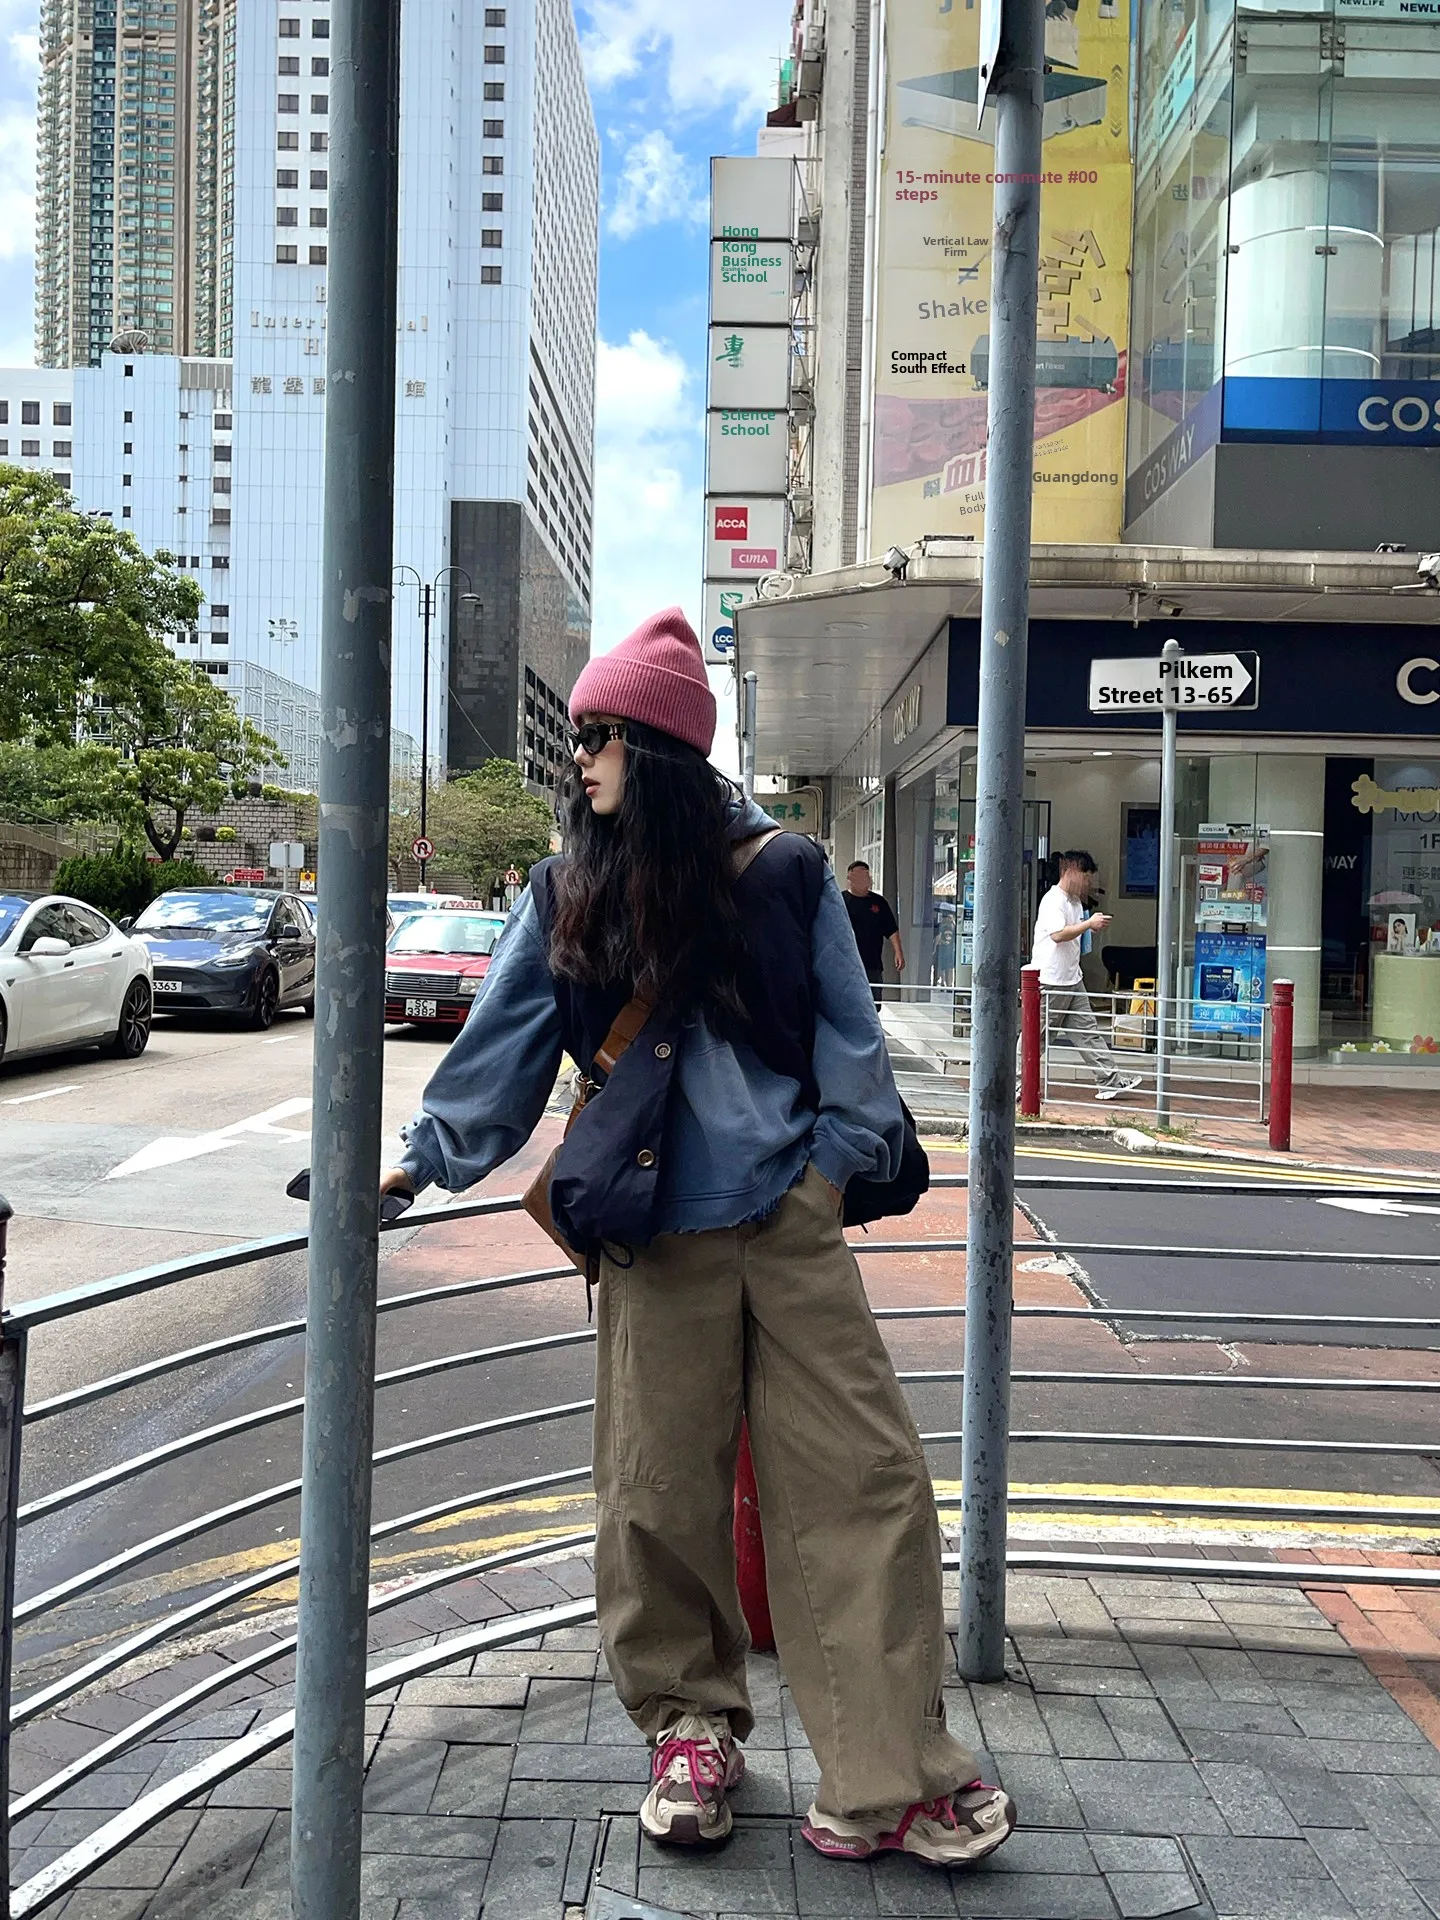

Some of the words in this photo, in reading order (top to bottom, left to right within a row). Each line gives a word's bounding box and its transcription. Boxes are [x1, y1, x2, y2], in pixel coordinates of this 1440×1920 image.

[1400, 3, 1440, 13] NEWL
[896, 170, 981, 184] 15-minute
[985, 171, 1063, 184] commute
[1067, 171, 1098, 184] #00
[895, 188, 938, 203] steps
[722, 226, 759, 240] Hong
[923, 236, 965, 246] Vertical
[967, 237, 989, 246] Law
[722, 241, 757, 255] Kong
[944, 247, 967, 257] Firm
[722, 255, 782, 267] Business
[722, 271, 768, 283] School
[918, 296, 988, 319] Shake
[891, 351, 947, 363] Compact
[891, 362, 927, 374] South
[931, 362, 966, 374] Effect
[721, 409, 776, 421] Science
[721, 423, 770, 436] School
[1032, 471, 1119, 485] Guangdong
[964, 491, 985, 503] Full
[959, 504, 986, 515] Body
[716, 519, 747, 528] ACCA
[1159, 661, 1233, 679] Pilkem
[1098, 686, 1164, 704] Street
[1170, 686, 1233, 704] 13-65
[449, 900, 480, 909] TAXI
[415, 1000, 429, 1009] SC
[407, 1007, 436, 1017] 3382
